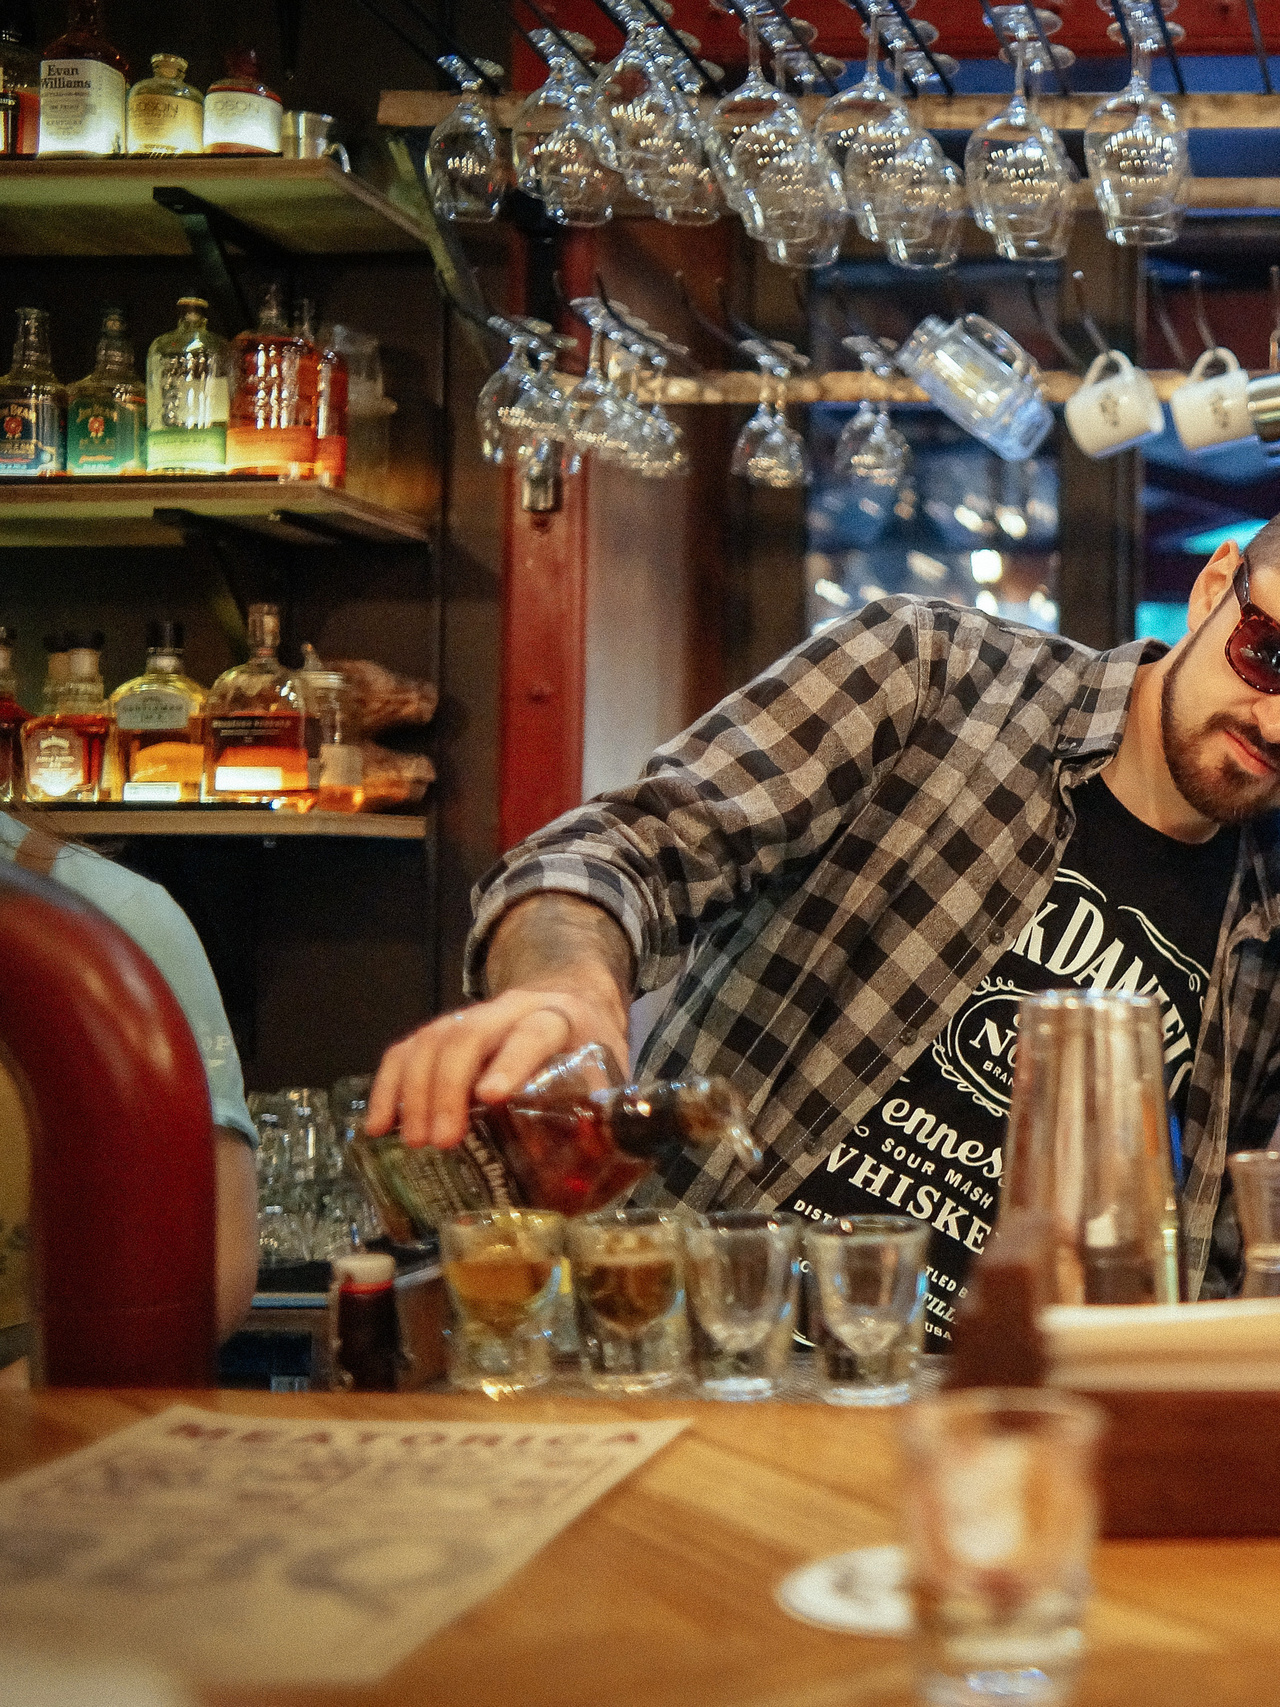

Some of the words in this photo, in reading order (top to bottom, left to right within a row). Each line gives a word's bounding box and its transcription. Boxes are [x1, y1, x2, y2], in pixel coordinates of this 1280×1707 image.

[41, 77, 91, 88] Williams
[47, 65, 79, 76] Evan
[982, 1060, 1015, 1087] BRAN
[881, 1098, 1005, 1187] ennes
[881, 1138, 936, 1176] SOUR
[944, 1168, 994, 1210] MASH
[826, 1141, 993, 1256] HISKE
[925, 1264, 958, 1292] TLED
